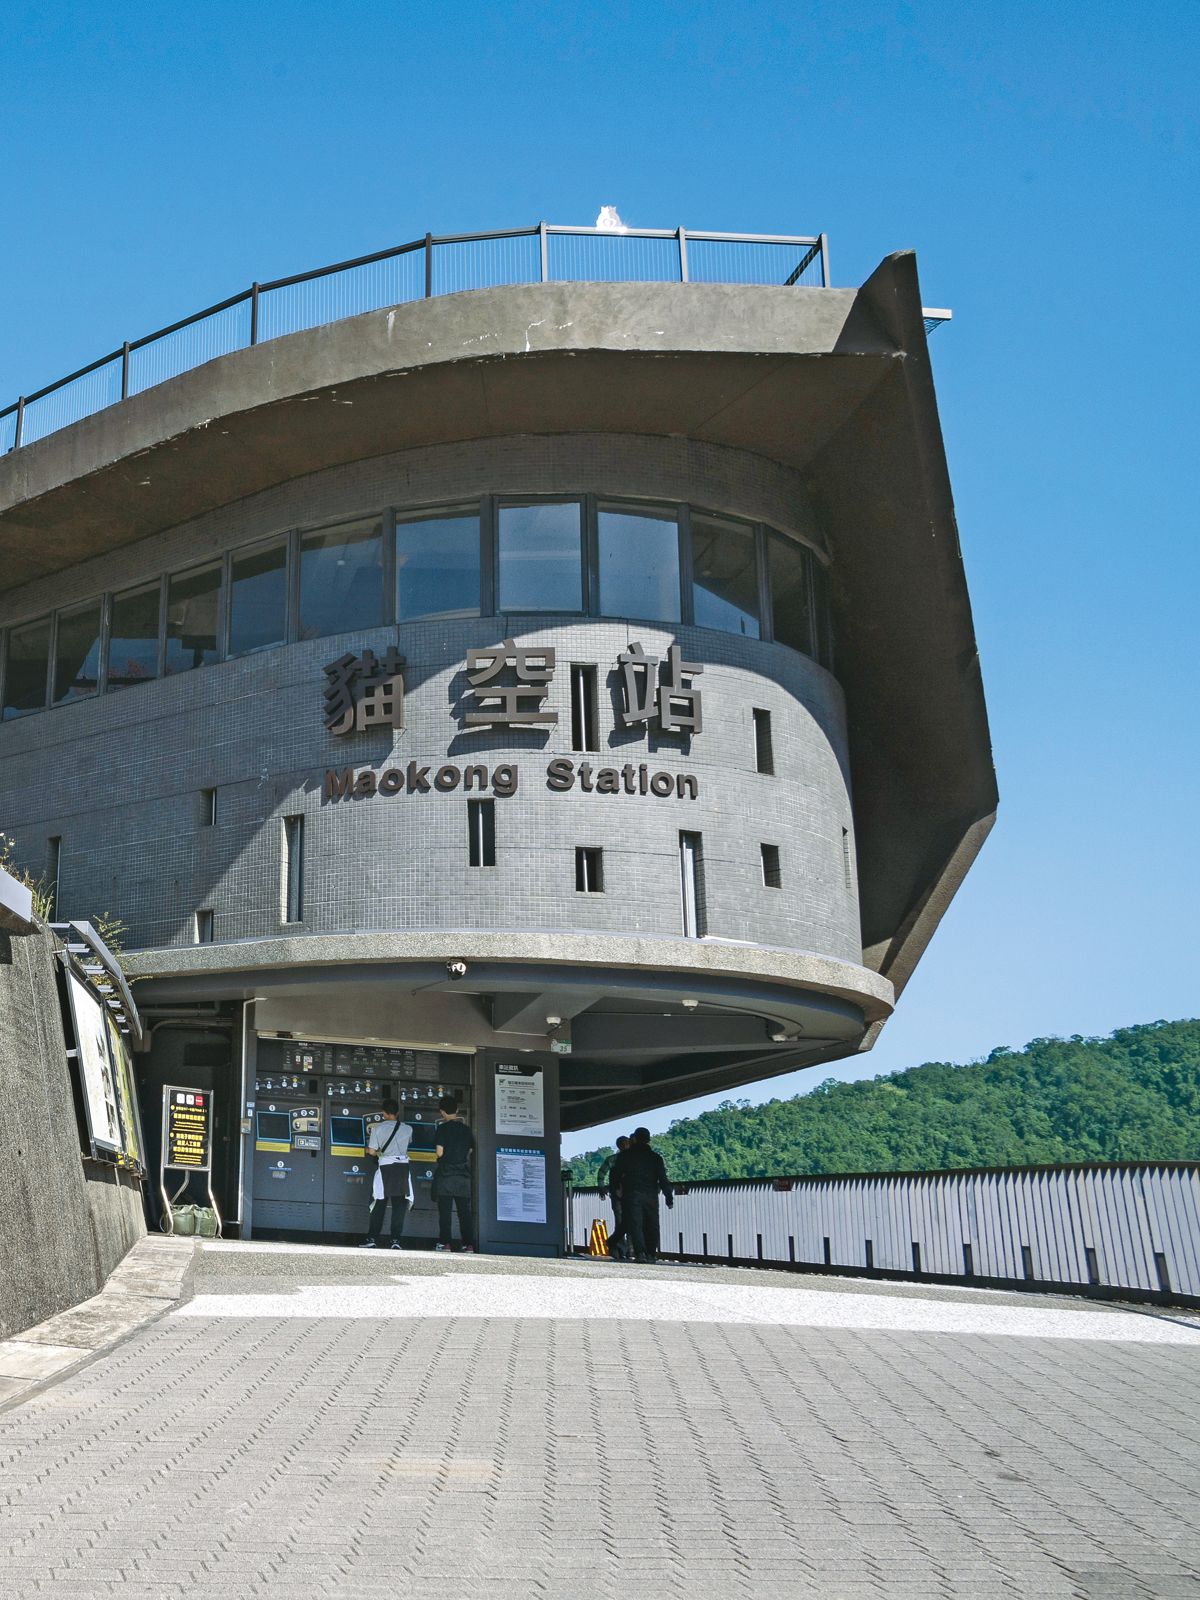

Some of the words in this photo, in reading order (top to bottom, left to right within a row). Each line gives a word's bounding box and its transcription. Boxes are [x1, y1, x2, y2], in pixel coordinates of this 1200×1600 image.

[323, 639, 703, 735] 貓空站
[324, 761, 518, 798] Maokong
[547, 759, 698, 798] Station
